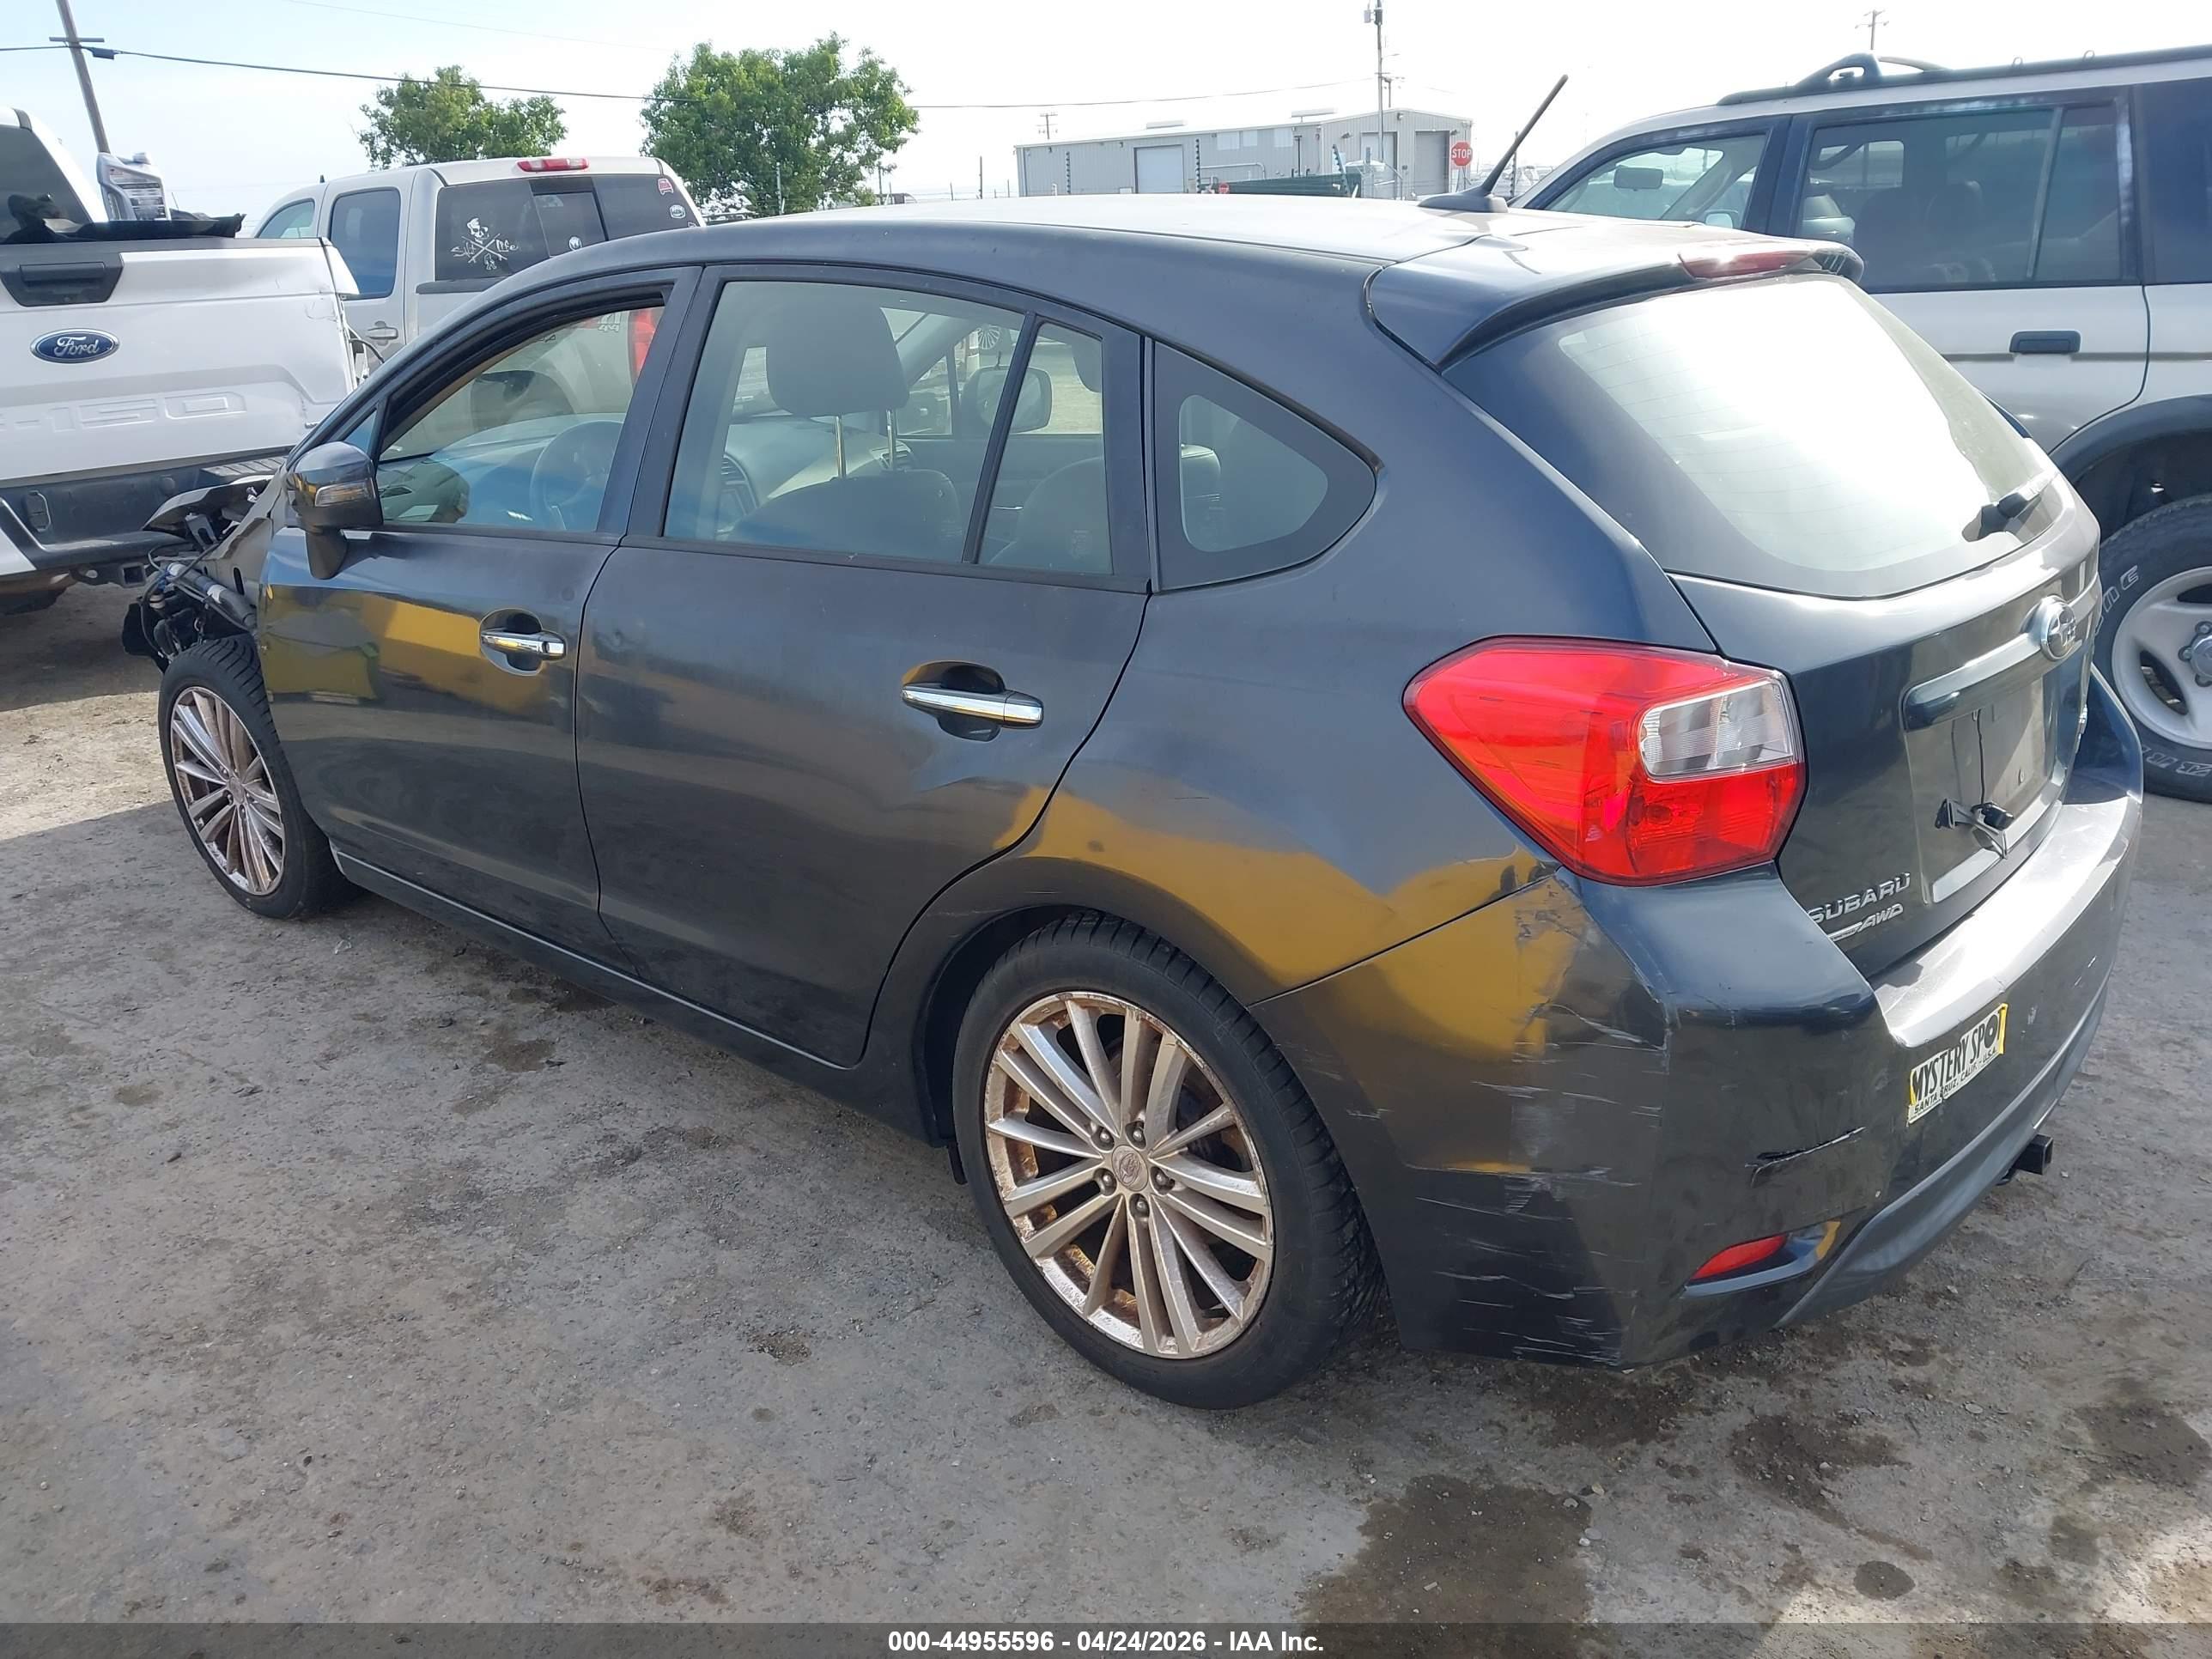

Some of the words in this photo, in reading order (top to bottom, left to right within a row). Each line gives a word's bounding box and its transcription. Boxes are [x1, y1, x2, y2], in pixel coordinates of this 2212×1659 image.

[1452, 148, 1472, 159] STOP
[495, 239, 519, 252] Life
[53, 336, 100, 356] Ford
[1808, 872, 1910, 924] SUBARU
[1857, 902, 1904, 933] AWD
[1912, 1035, 1969, 1102] MYSTERY
[1970, 1006, 2006, 1064] SPOT
[1914, 1091, 1938, 1114] SANTA
